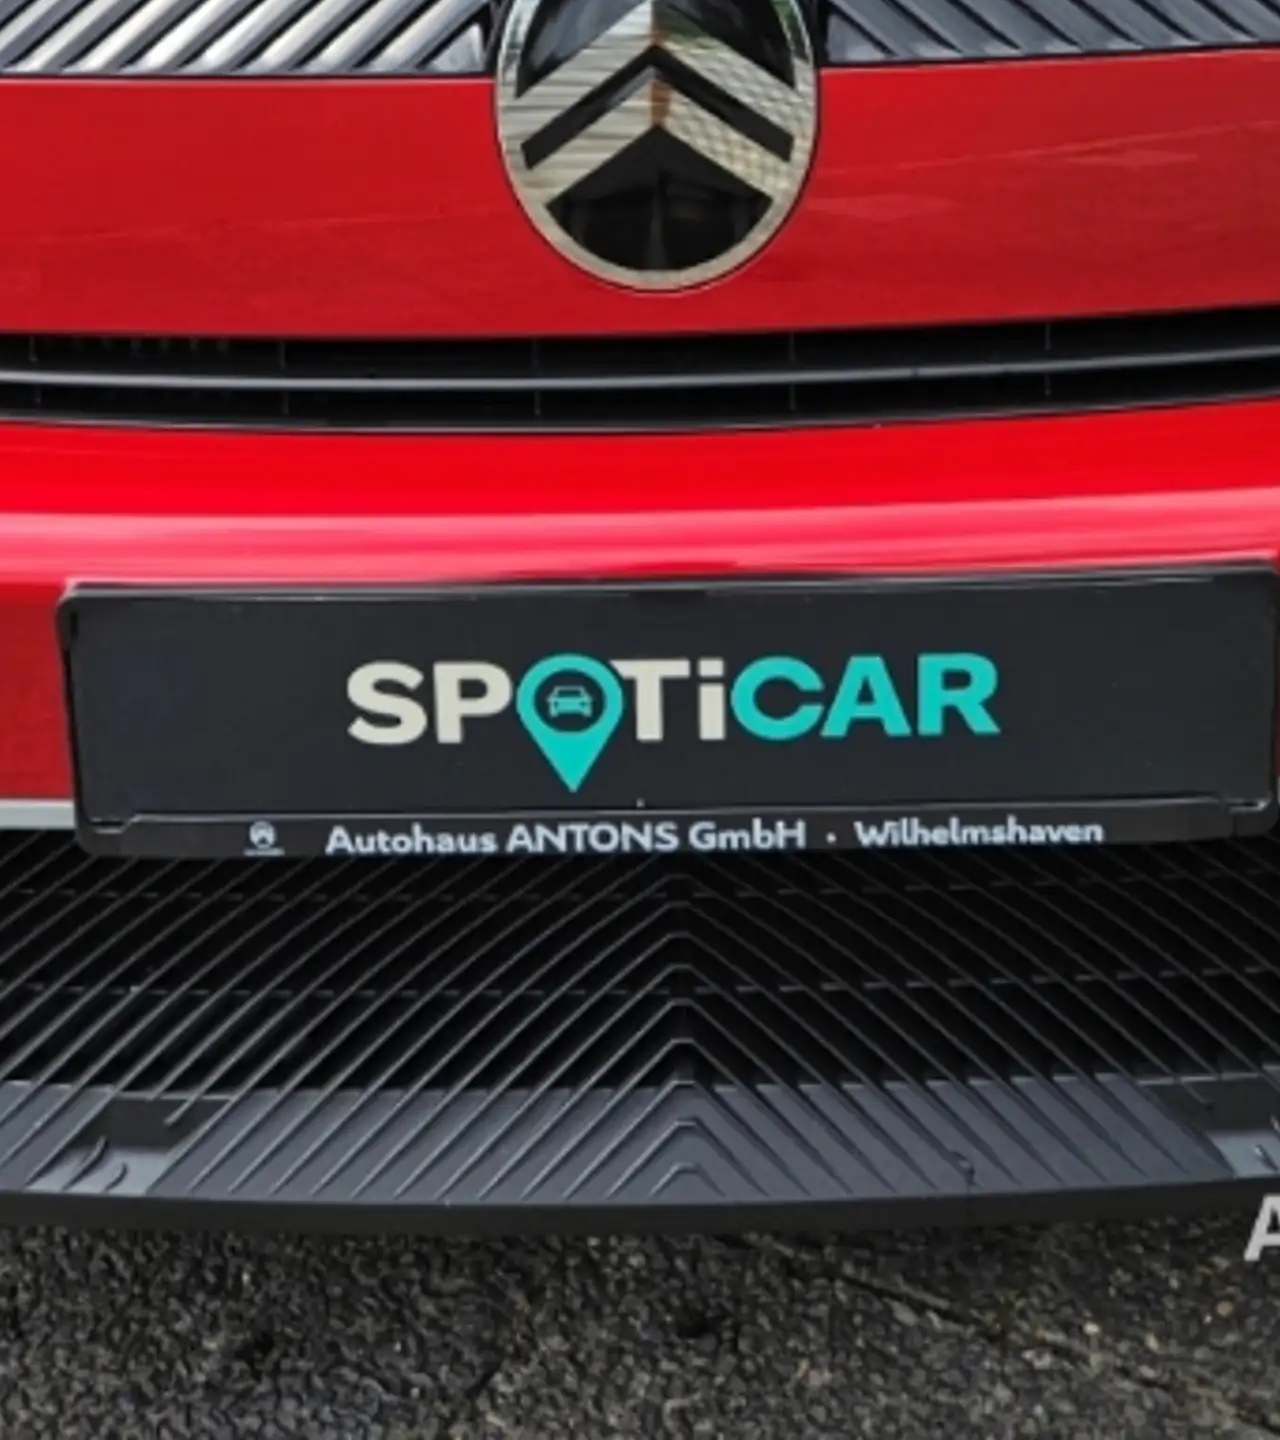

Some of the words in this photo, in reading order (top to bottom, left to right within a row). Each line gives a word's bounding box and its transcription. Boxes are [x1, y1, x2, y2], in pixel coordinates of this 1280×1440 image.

[325, 824, 498, 855] Autohaus
[505, 821, 679, 853] ANTONS
[688, 818, 806, 850] GmbH
[853, 815, 1104, 847] Wilhelmshaven
